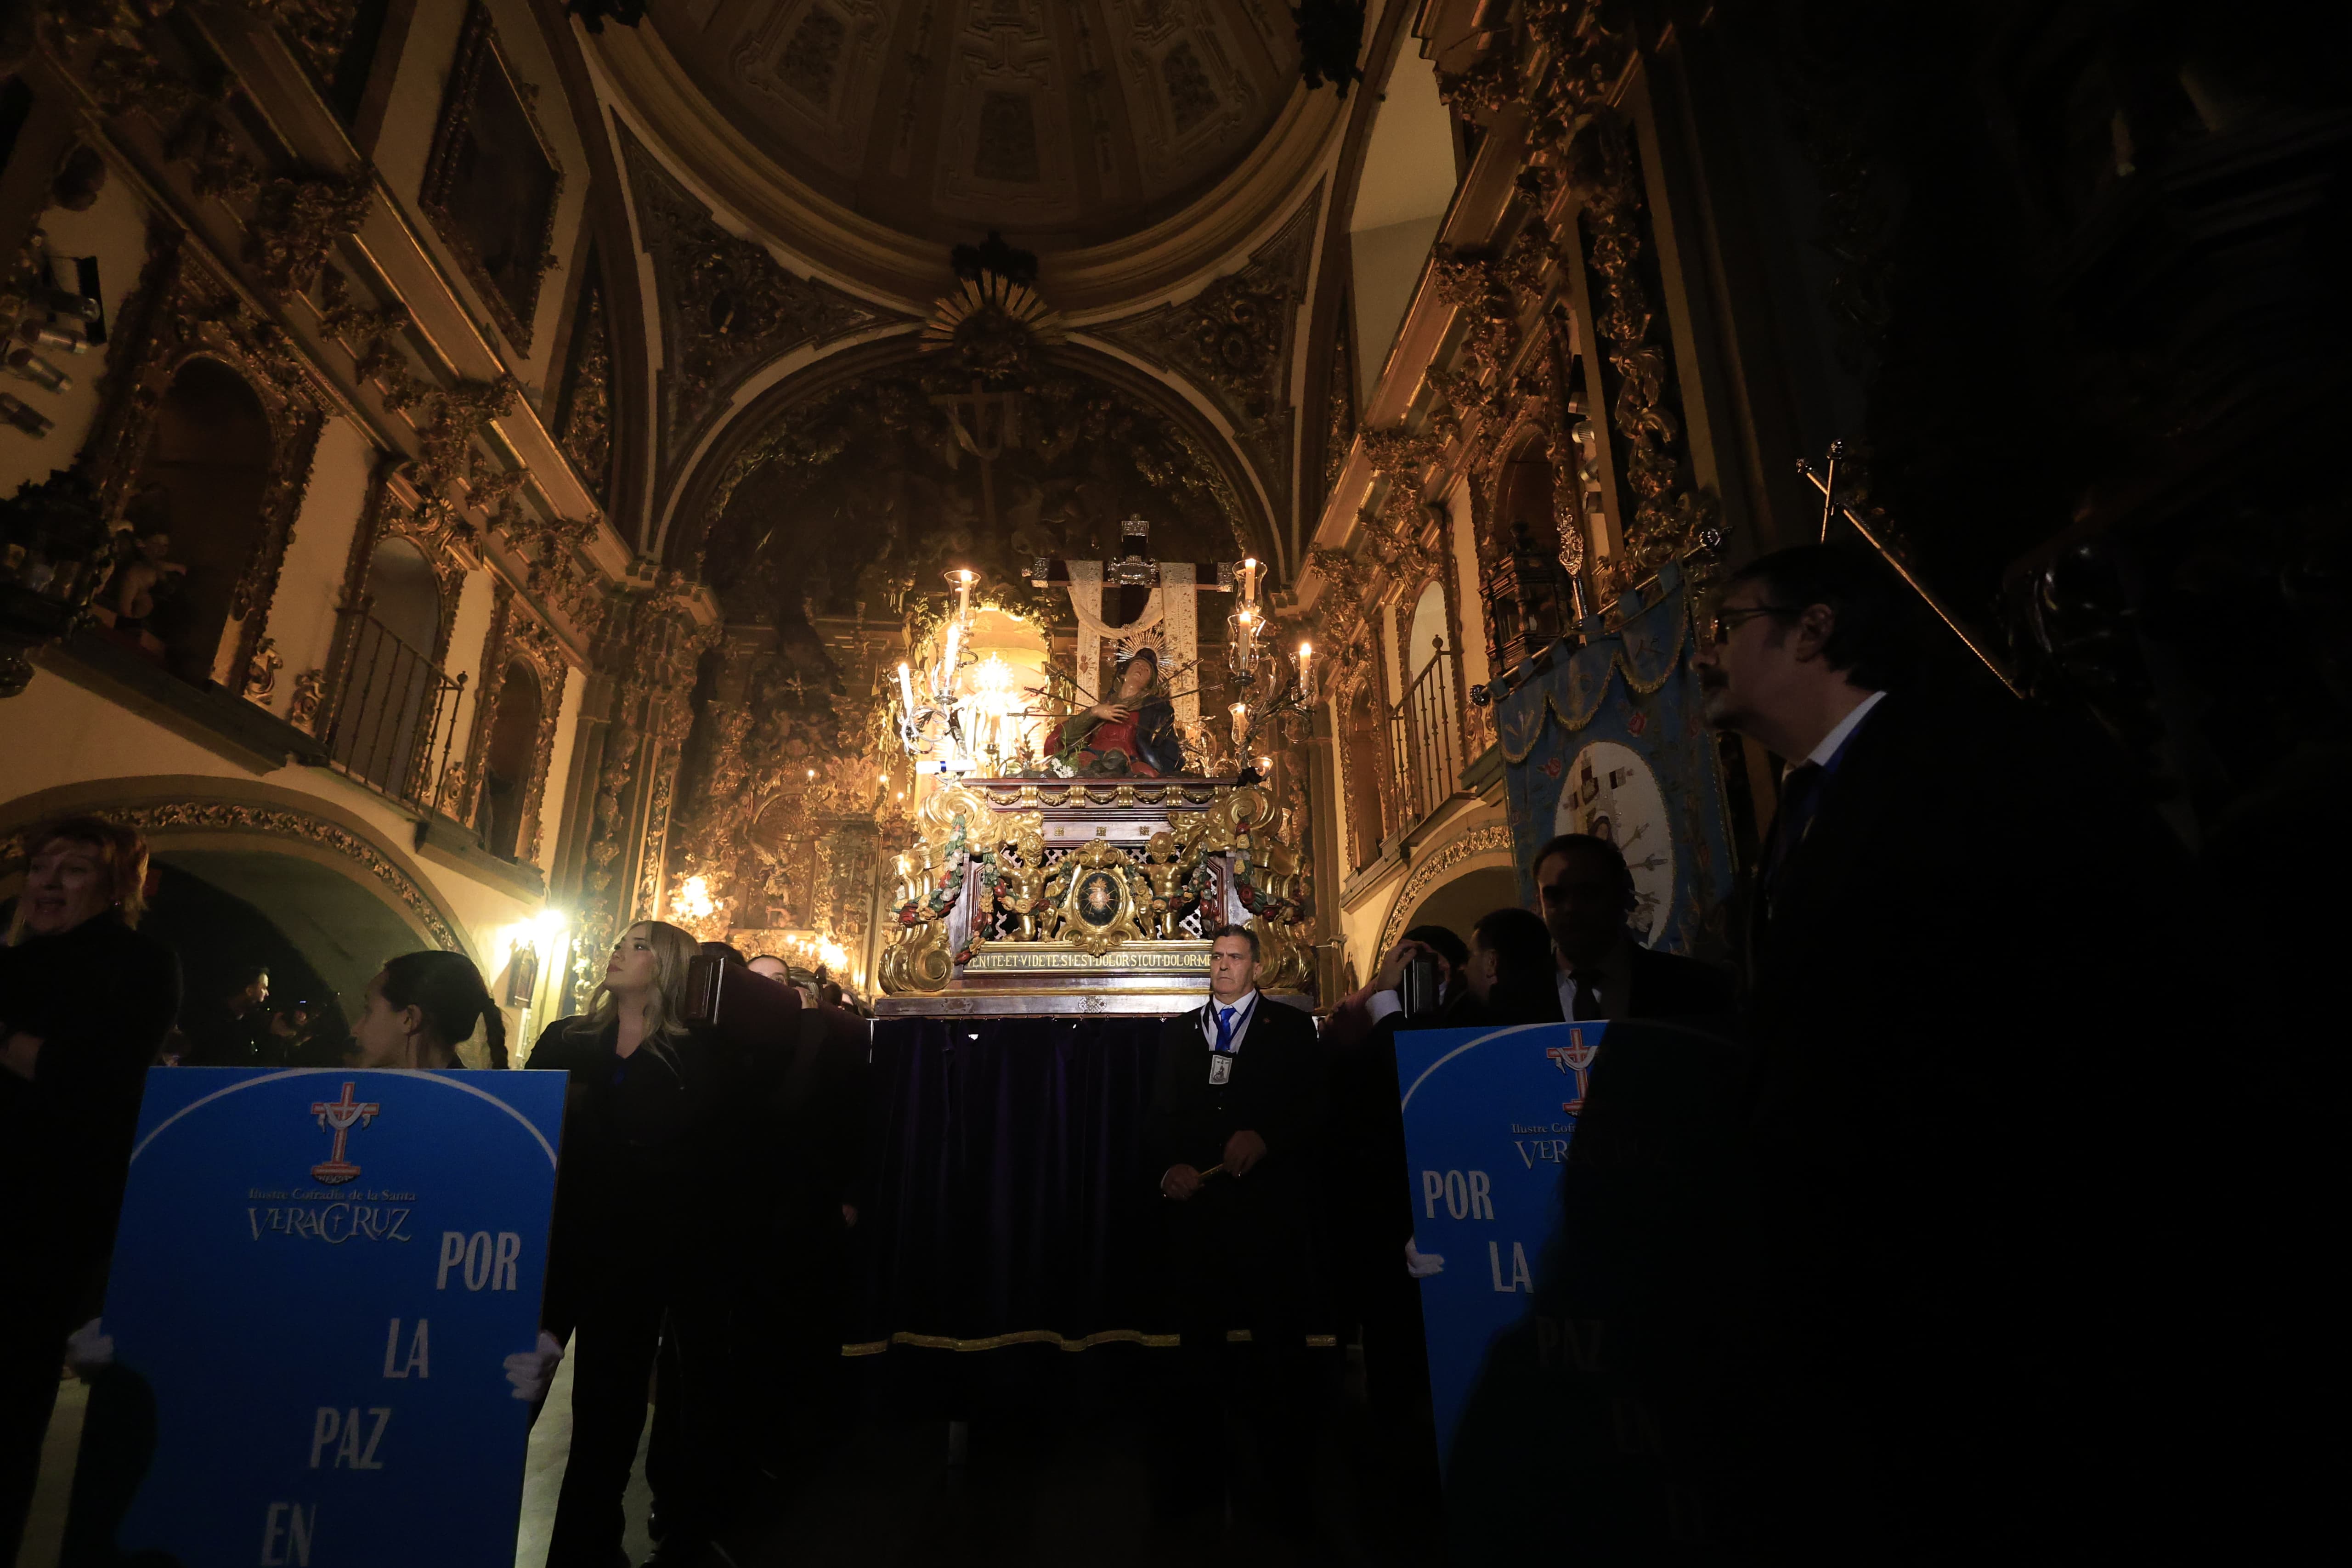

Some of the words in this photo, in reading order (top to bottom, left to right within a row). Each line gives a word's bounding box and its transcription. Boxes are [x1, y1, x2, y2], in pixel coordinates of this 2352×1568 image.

[1511, 1124, 1548, 1133] Ilustre
[382, 1189, 416, 1201] Santa
[1422, 1170, 1495, 1220] POR
[248, 1203, 411, 1244] VERACRUZ
[436, 1231, 521, 1291] POR
[1489, 1241, 1534, 1293] LA
[383, 1318, 429, 1379] LA
[310, 1406, 391, 1470] PAZ
[261, 1502, 316, 1567] EN
